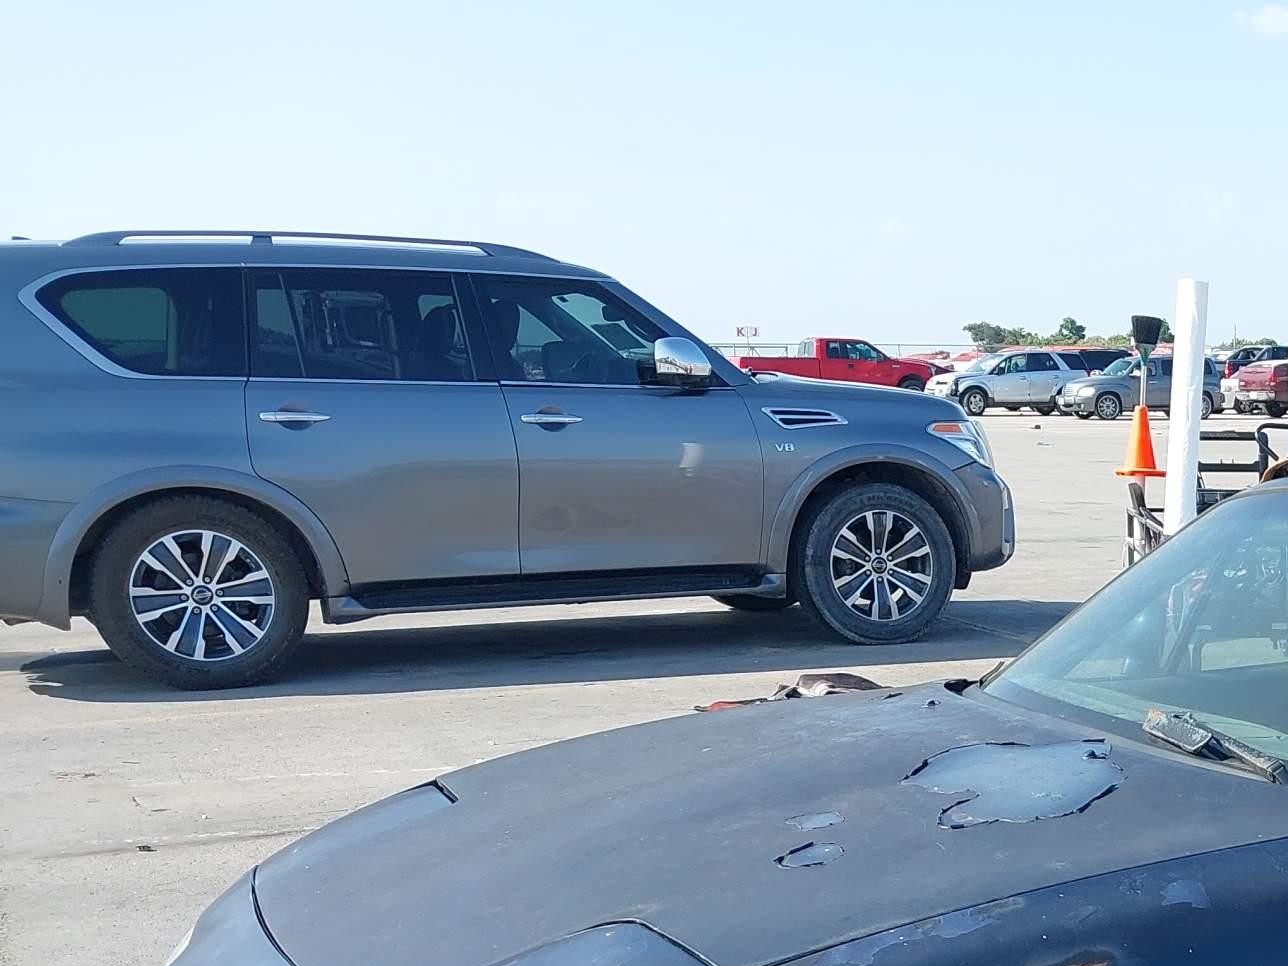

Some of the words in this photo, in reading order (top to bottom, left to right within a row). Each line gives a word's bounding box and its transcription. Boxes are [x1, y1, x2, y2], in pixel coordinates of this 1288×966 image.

[736, 327, 745, 337] K
[752, 327, 758, 337] J
[775, 443, 795, 452] V8
